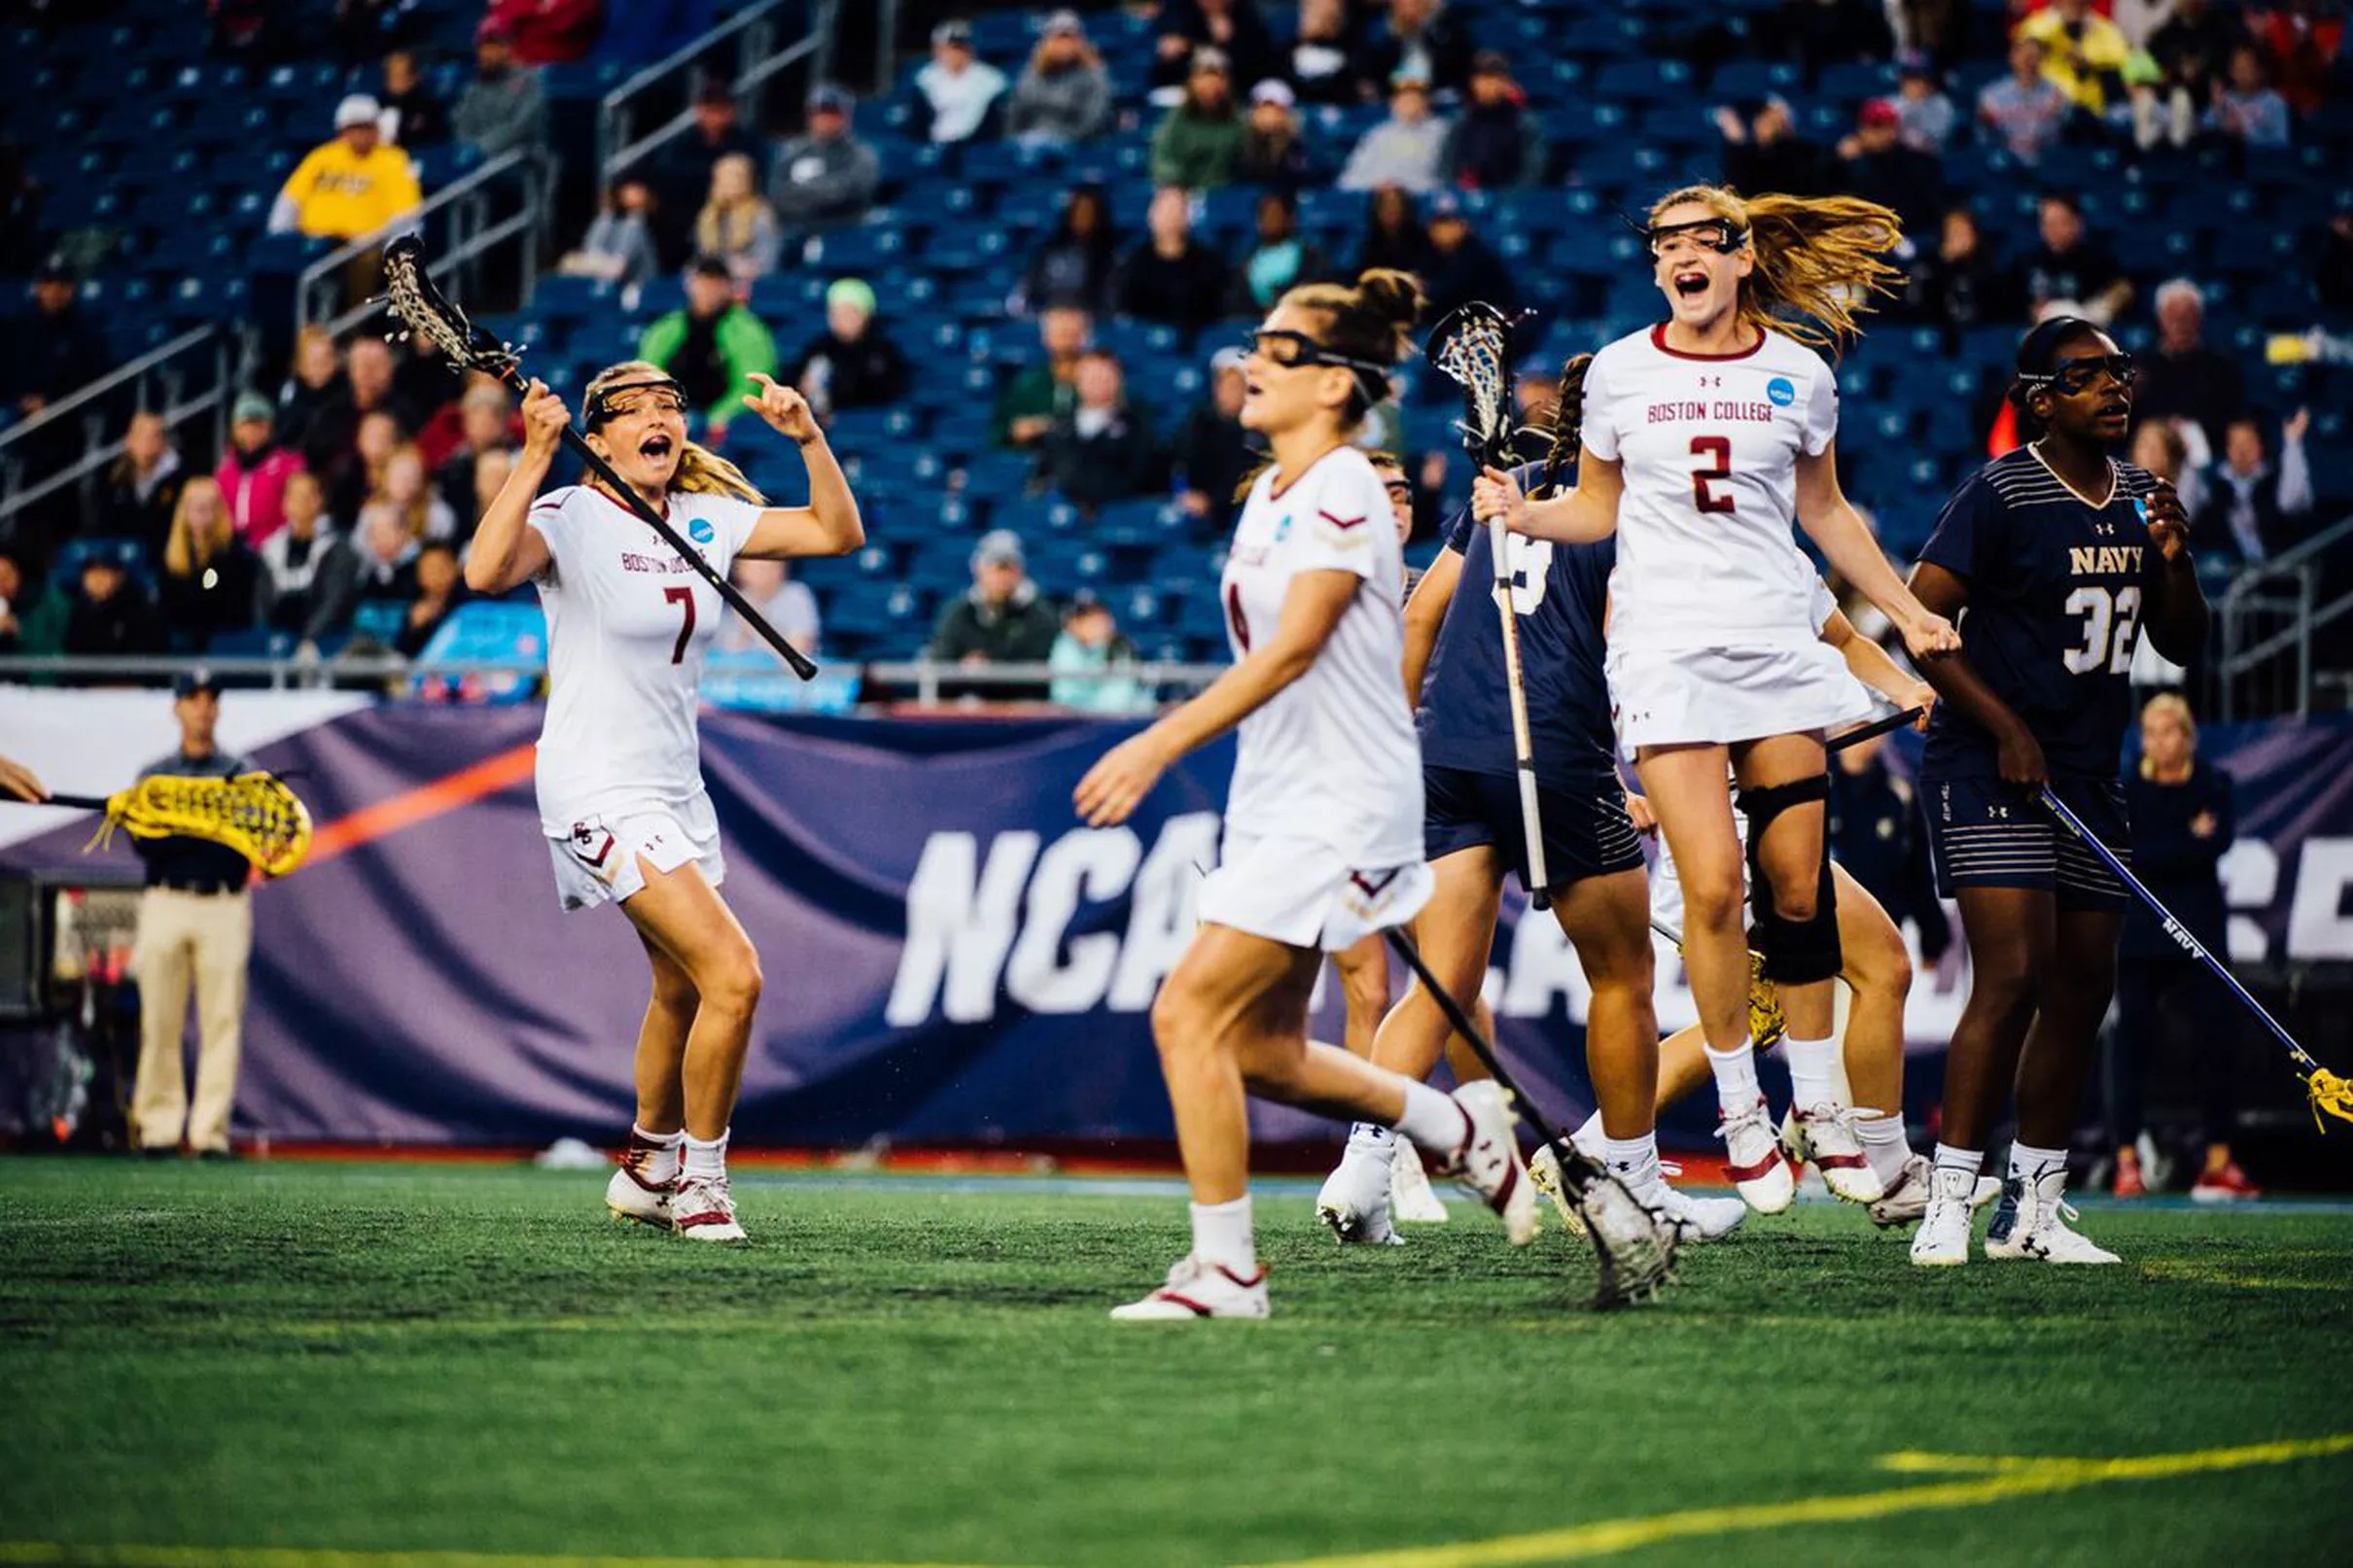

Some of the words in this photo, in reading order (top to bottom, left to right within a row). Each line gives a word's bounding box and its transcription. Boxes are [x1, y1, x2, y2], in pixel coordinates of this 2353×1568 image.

[1648, 404, 1706, 423] BOSTON
[1714, 401, 1773, 422] COLLEGE
[1690, 436, 1735, 513] 2
[2069, 546, 2143, 575] NAVY
[664, 586, 695, 665] 7
[2063, 586, 2142, 675] 32
[885, 812, 1224, 1026] NCA
[2162, 918, 2205, 958] NAVY
